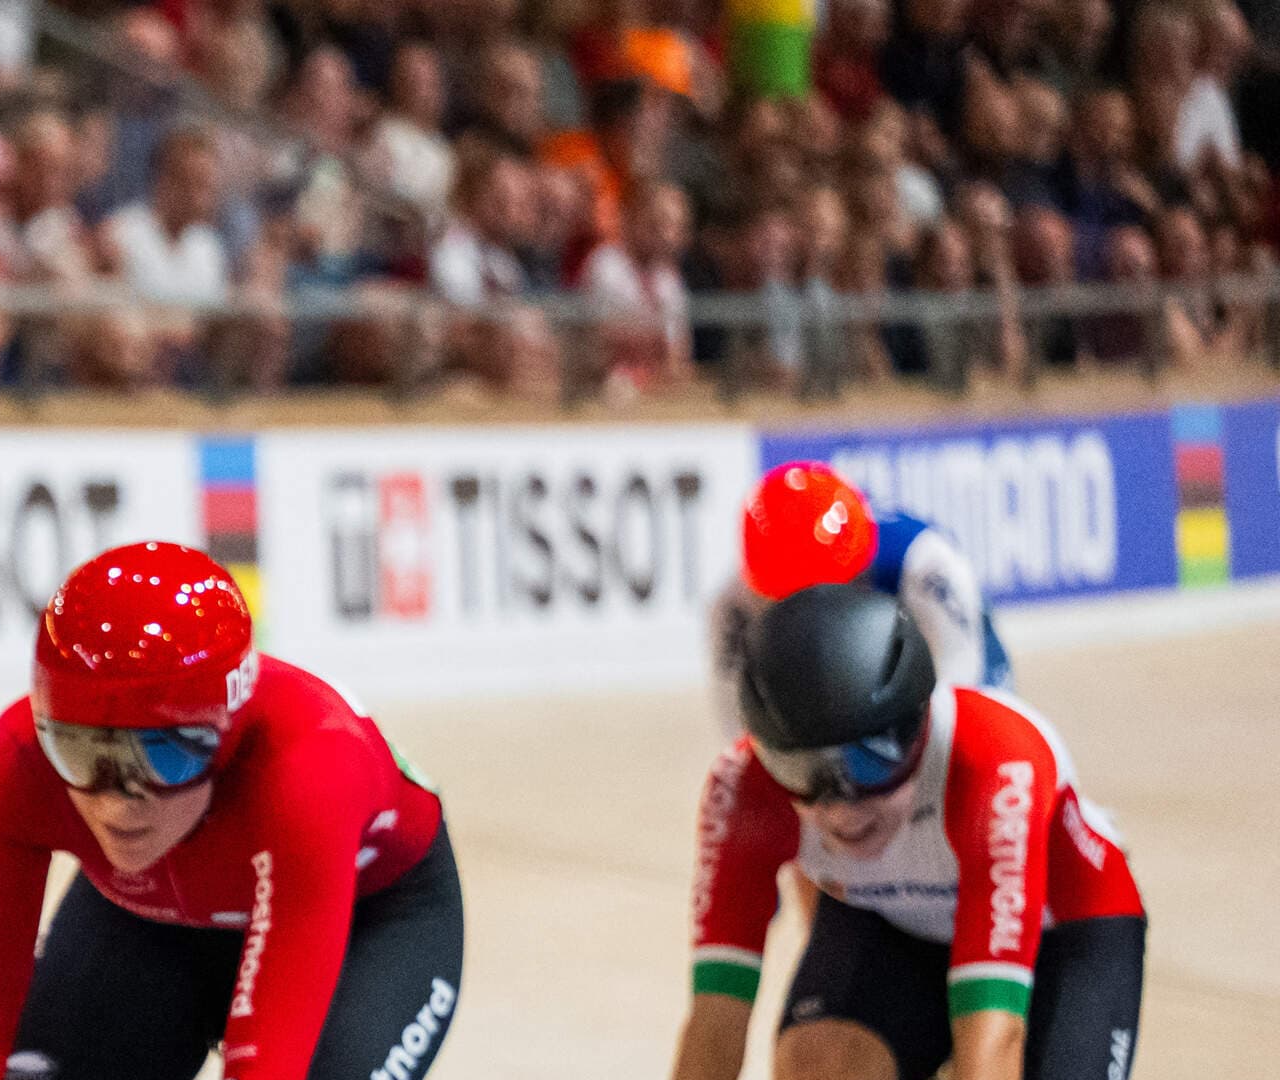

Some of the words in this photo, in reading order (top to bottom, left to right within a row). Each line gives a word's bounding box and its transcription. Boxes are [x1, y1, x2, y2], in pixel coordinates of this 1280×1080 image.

[449, 472, 704, 612] TISSOT
[230, 850, 273, 1017] postnord
[986, 760, 1033, 955] PORTUGAL
